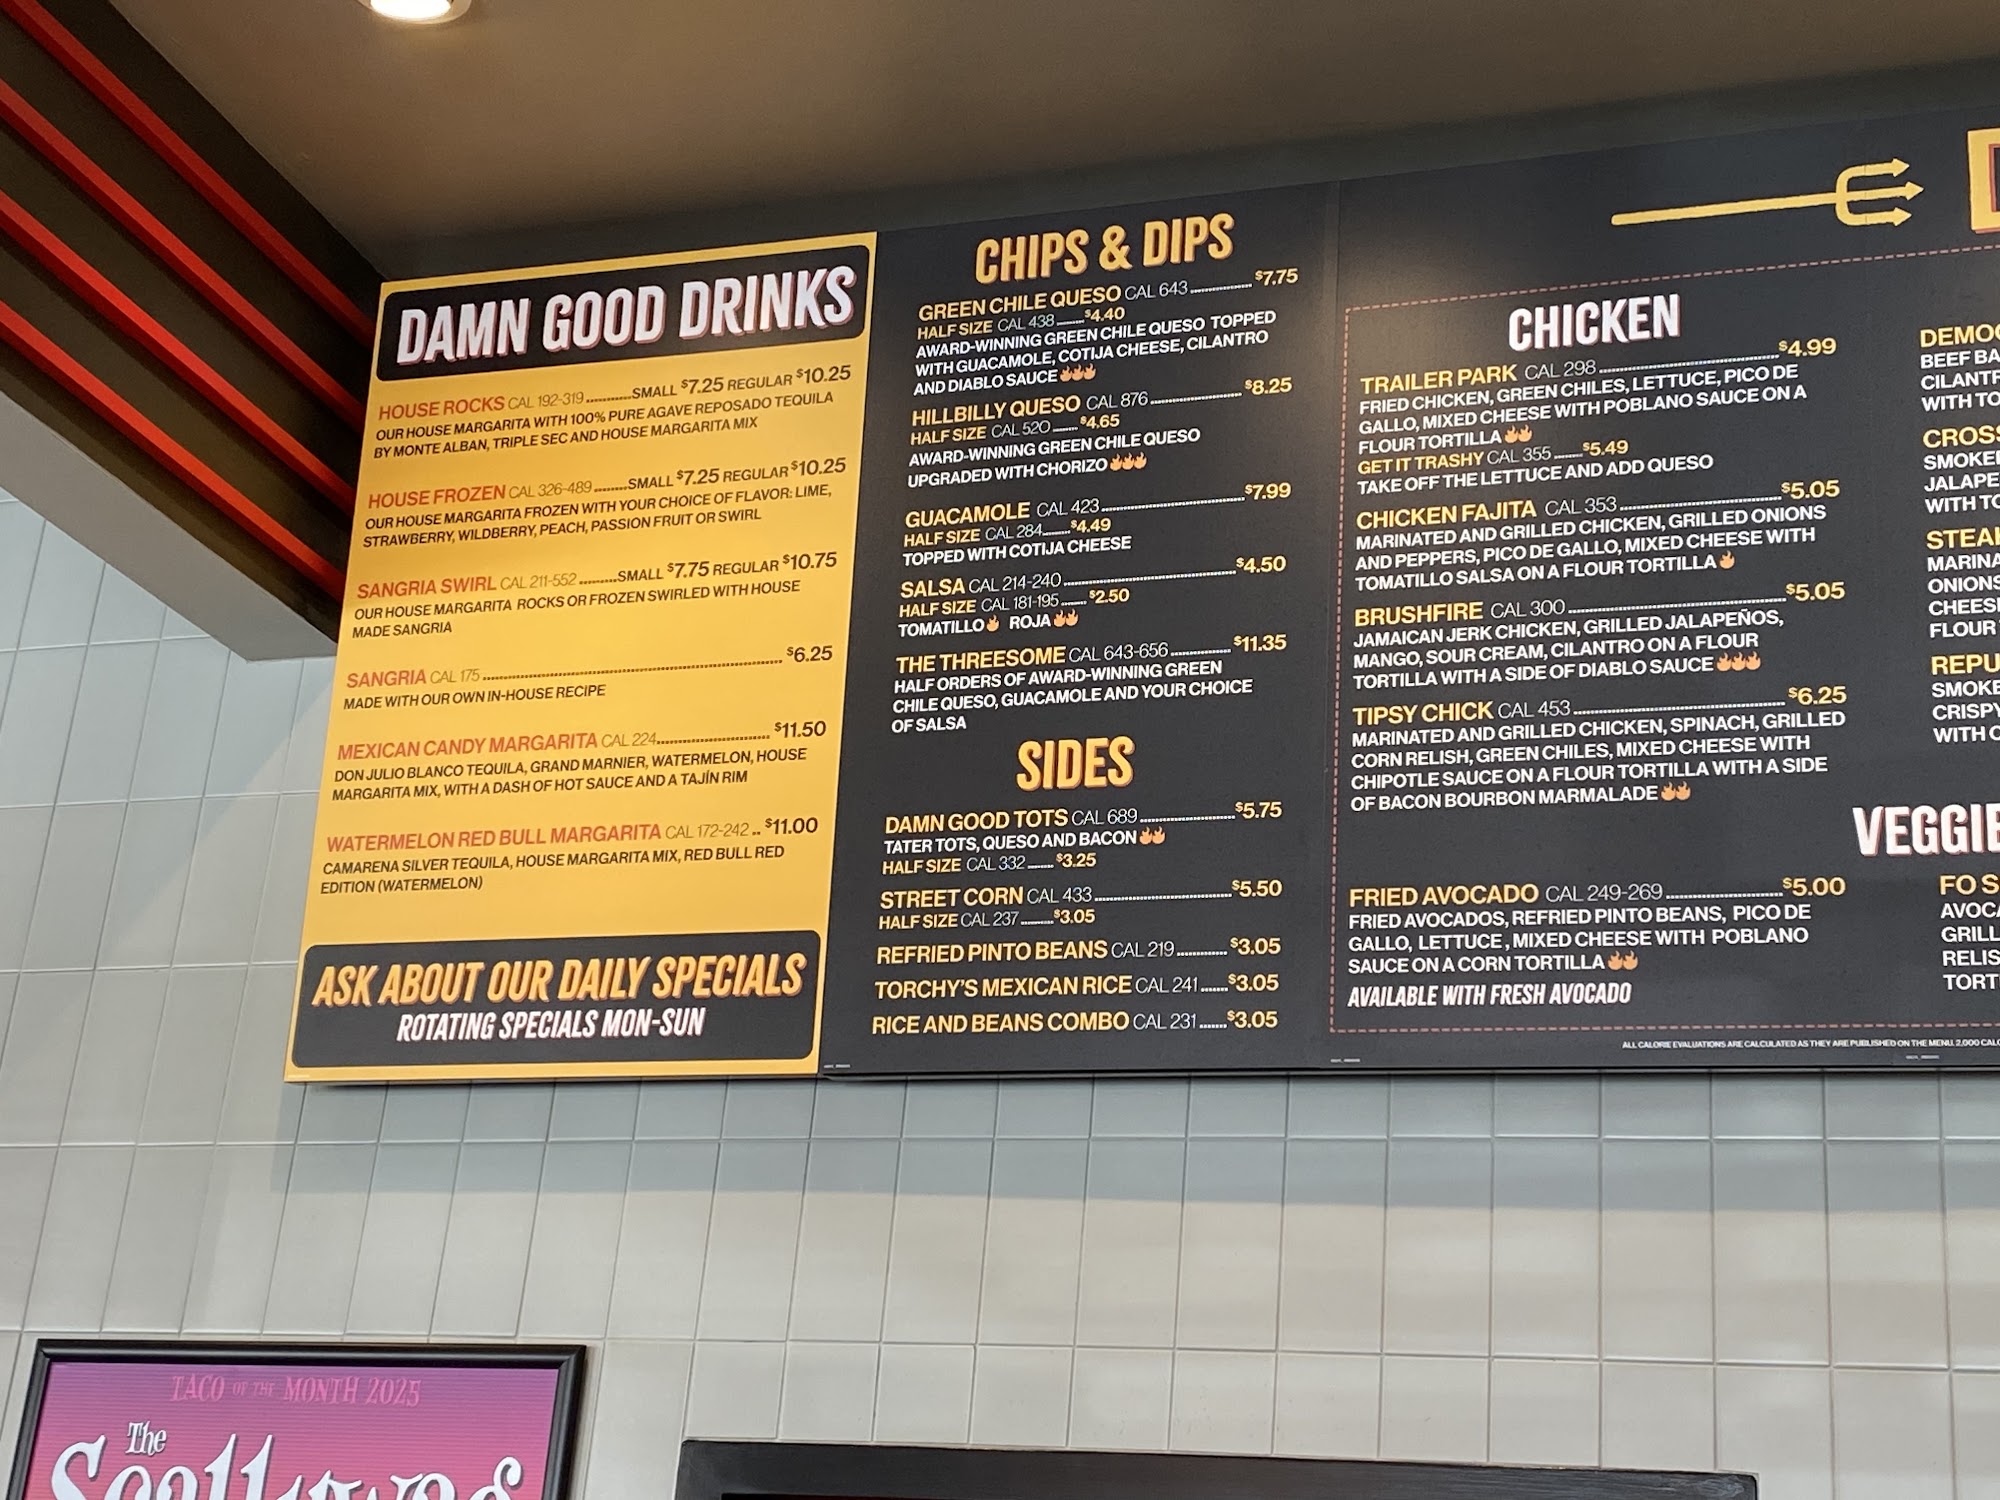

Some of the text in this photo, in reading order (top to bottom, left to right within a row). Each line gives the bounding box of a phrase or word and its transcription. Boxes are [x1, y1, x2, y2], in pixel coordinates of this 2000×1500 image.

[976, 213, 1234, 284] CHIPS & DIPS
[919, 268, 1298, 321] GREEN CHILE QUESO CAL 643 $7.75
[397, 266, 857, 364] DAMN GOOD DRINKS
[917, 306, 1125, 340] HALF SIZE CAL 438 $4.40
[1509, 294, 1679, 351] CHICKEN
[1360, 337, 1836, 394] TRAILER PARK CAL 298 $4.99
[1920, 350, 1971, 370] BEEF
[378, 364, 851, 421] HOUSE ROCKS CAL 192-319 SMALL $7.25 REGULAR $10.25
[913, 369, 1058, 396] AND DIABLO SAUCE
[375, 392, 833, 441] OUR HOUSE MARGARITA WITH 100% PURE AGAVE REPOSADO TEQUILA
[912, 377, 1292, 426] HILLBILLY QUESO CAL 876 $8.25
[1922, 393, 1973, 412] WITH
[1358, 439, 1628, 475] GET IT TRASHY CAL 355 $5.49
[1925, 495, 1976, 514] WITH
[900, 556, 1286, 598] SALSA CAL 214-240 $4.50
[1355, 582, 1845, 627] BRUSHFIRE CAL 300 $5.05
[898, 614, 1051, 637] TOMATILLO ROJA
[1353, 609, 1784, 648] JAMAICAN JERK CHICKEN, GRILLED JALAPEÑOS,
[1930, 620, 1996, 639] FLOUR
[343, 684, 606, 709] MADE WITH OUR OWN IN-HOUSE RECIPE
[1352, 686, 1847, 725] TIPSY CHICK CAL 453 $6.25
[337, 720, 826, 760] MEXICAN CANDY MARGARITA CAL 224 $11.50
[1933, 725, 1985, 743] WITH
[1017, 736, 1135, 791] SIDES
[886, 802, 1282, 834] DAMN GOOD TOTS CAL 689 $5.75
[1350, 877, 1845, 907] FRIED AVOCADO CAL 249-269 $5.00
[1939, 874, 1978, 896] FO
[877, 937, 1281, 964] REFRIED PINTO BEANS CAL 219 $3.05
[311, 953, 807, 1007] ASK ABOUT OUR DAILY SPECIALS
[875, 973, 1279, 999] TORCHY'S MEXICAN RICE CAL 241 $3.05
[1347, 982, 1632, 1008] AVAILABLE WITH FRESH AVOCADO
[396, 1007, 706, 1042] ROTATING SPECIALS MON-SUN
[1622, 1041, 1637, 1049] ALL
[1638, 1041, 1671, 1049] CALORIE
[1673, 1041, 1726, 1049] EVALUATIONS
[1744, 1040, 1796, 1048] CALCULATED
[1911, 1039, 1927, 1047] THE
[170, 1374, 225, 1402] TACO
[283, 1376, 359, 1404] MONTH
[365, 1376, 422, 1407] 2025
[125, 1421, 167, 1456] The
